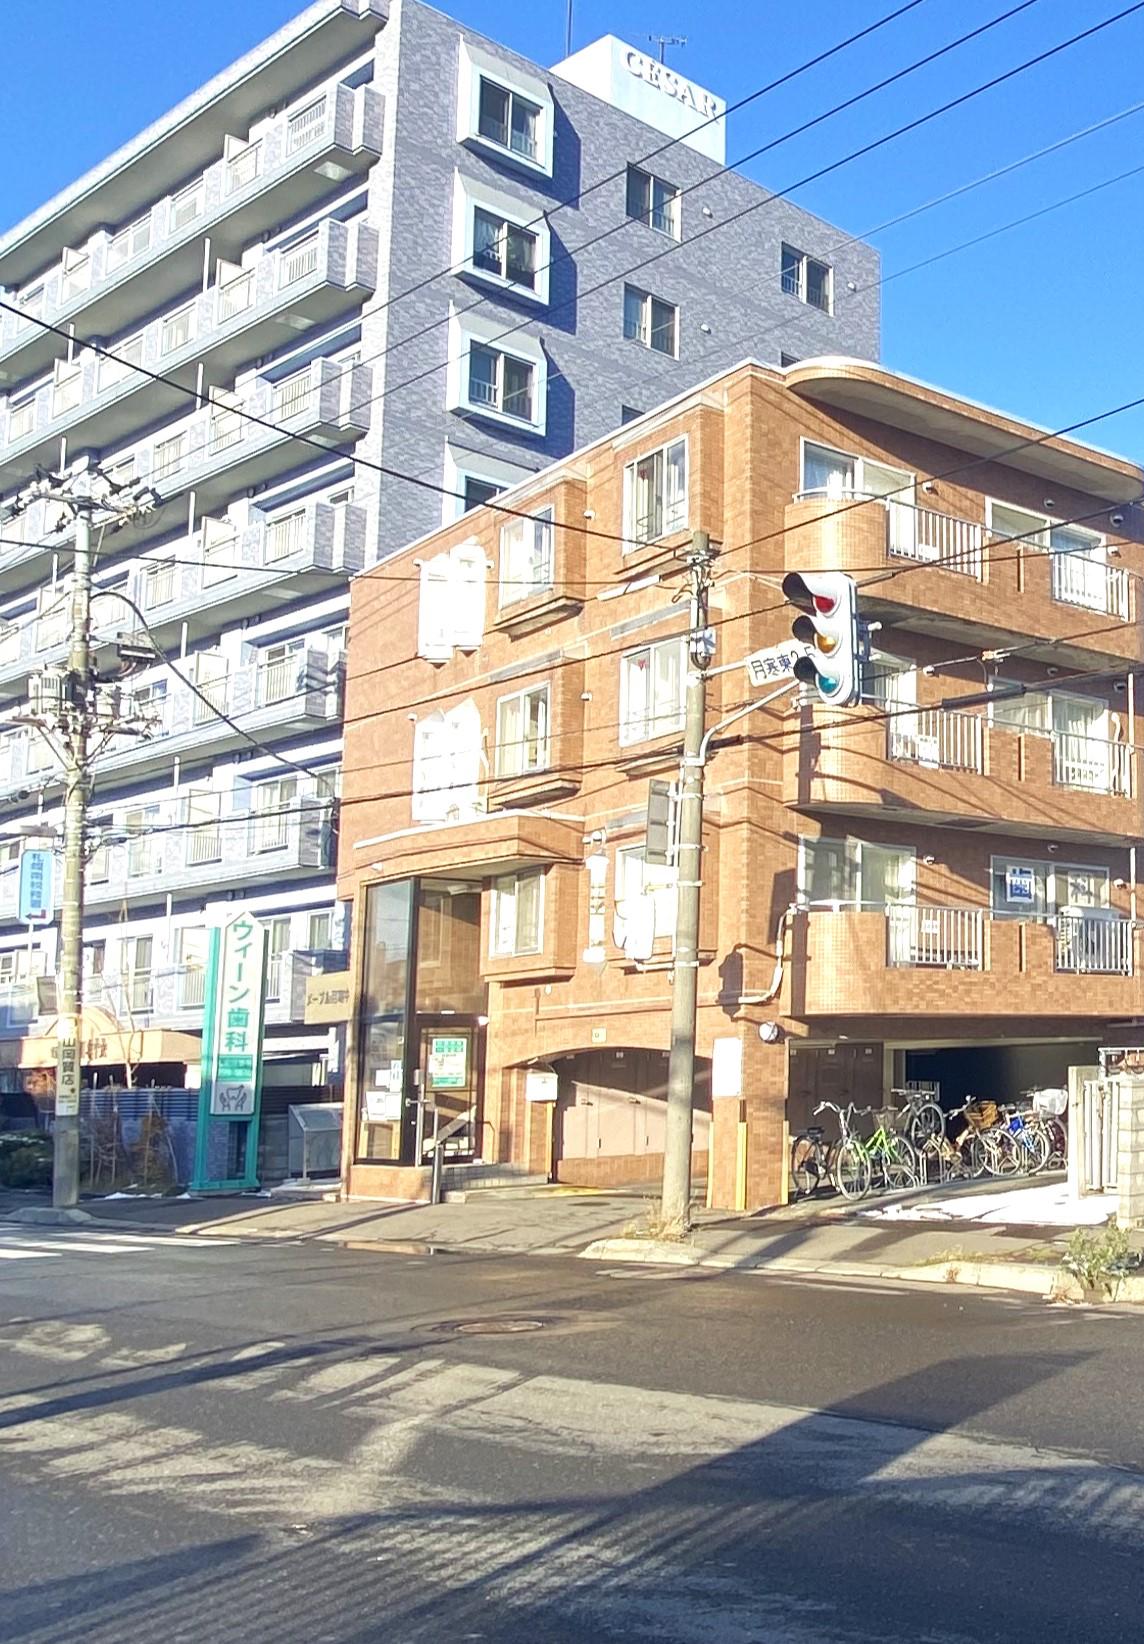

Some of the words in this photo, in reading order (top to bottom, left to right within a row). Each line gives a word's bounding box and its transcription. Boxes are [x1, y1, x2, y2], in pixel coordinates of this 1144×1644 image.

[225, 920, 254, 1052] ウィーン歯科
